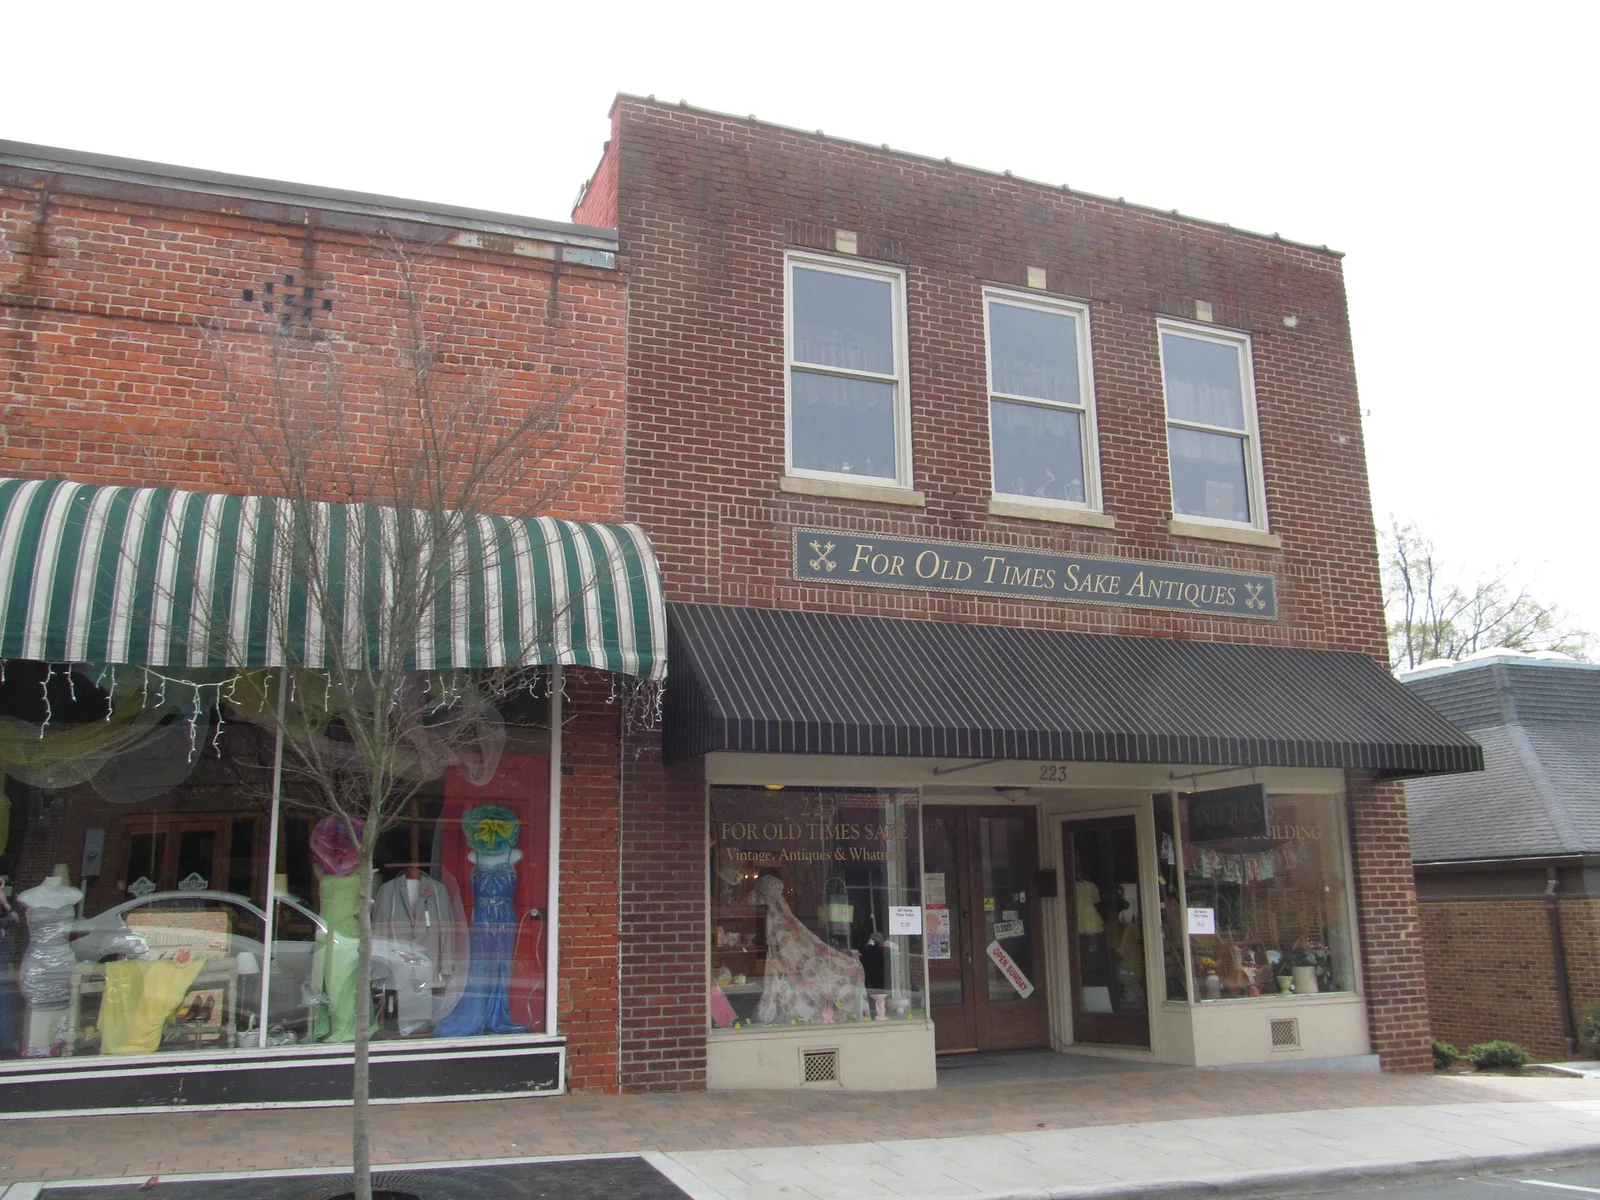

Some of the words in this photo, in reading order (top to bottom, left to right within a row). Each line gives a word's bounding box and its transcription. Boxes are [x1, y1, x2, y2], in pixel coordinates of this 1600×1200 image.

[848, 544, 905, 577] FOR
[915, 550, 972, 582] OLD
[982, 555, 1056, 590] TIMES
[1063, 564, 1120, 596] SAKE
[1127, 570, 1237, 607] ANTIQUES
[1039, 765, 1067, 783] 223
[800, 796, 837, 817] 223
[721, 822, 760, 840] FOR
[763, 822, 802, 840] OLD
[807, 822, 860, 841] TIMES
[1253, 825, 1321, 840] ILDING
[726, 847, 776, 864] Vintage,
[779, 847, 832, 864] Antiques
[834, 847, 847, 861] &
[992, 947, 1008, 967] OPEN
[1006, 966, 1028, 991] SUNDAY
